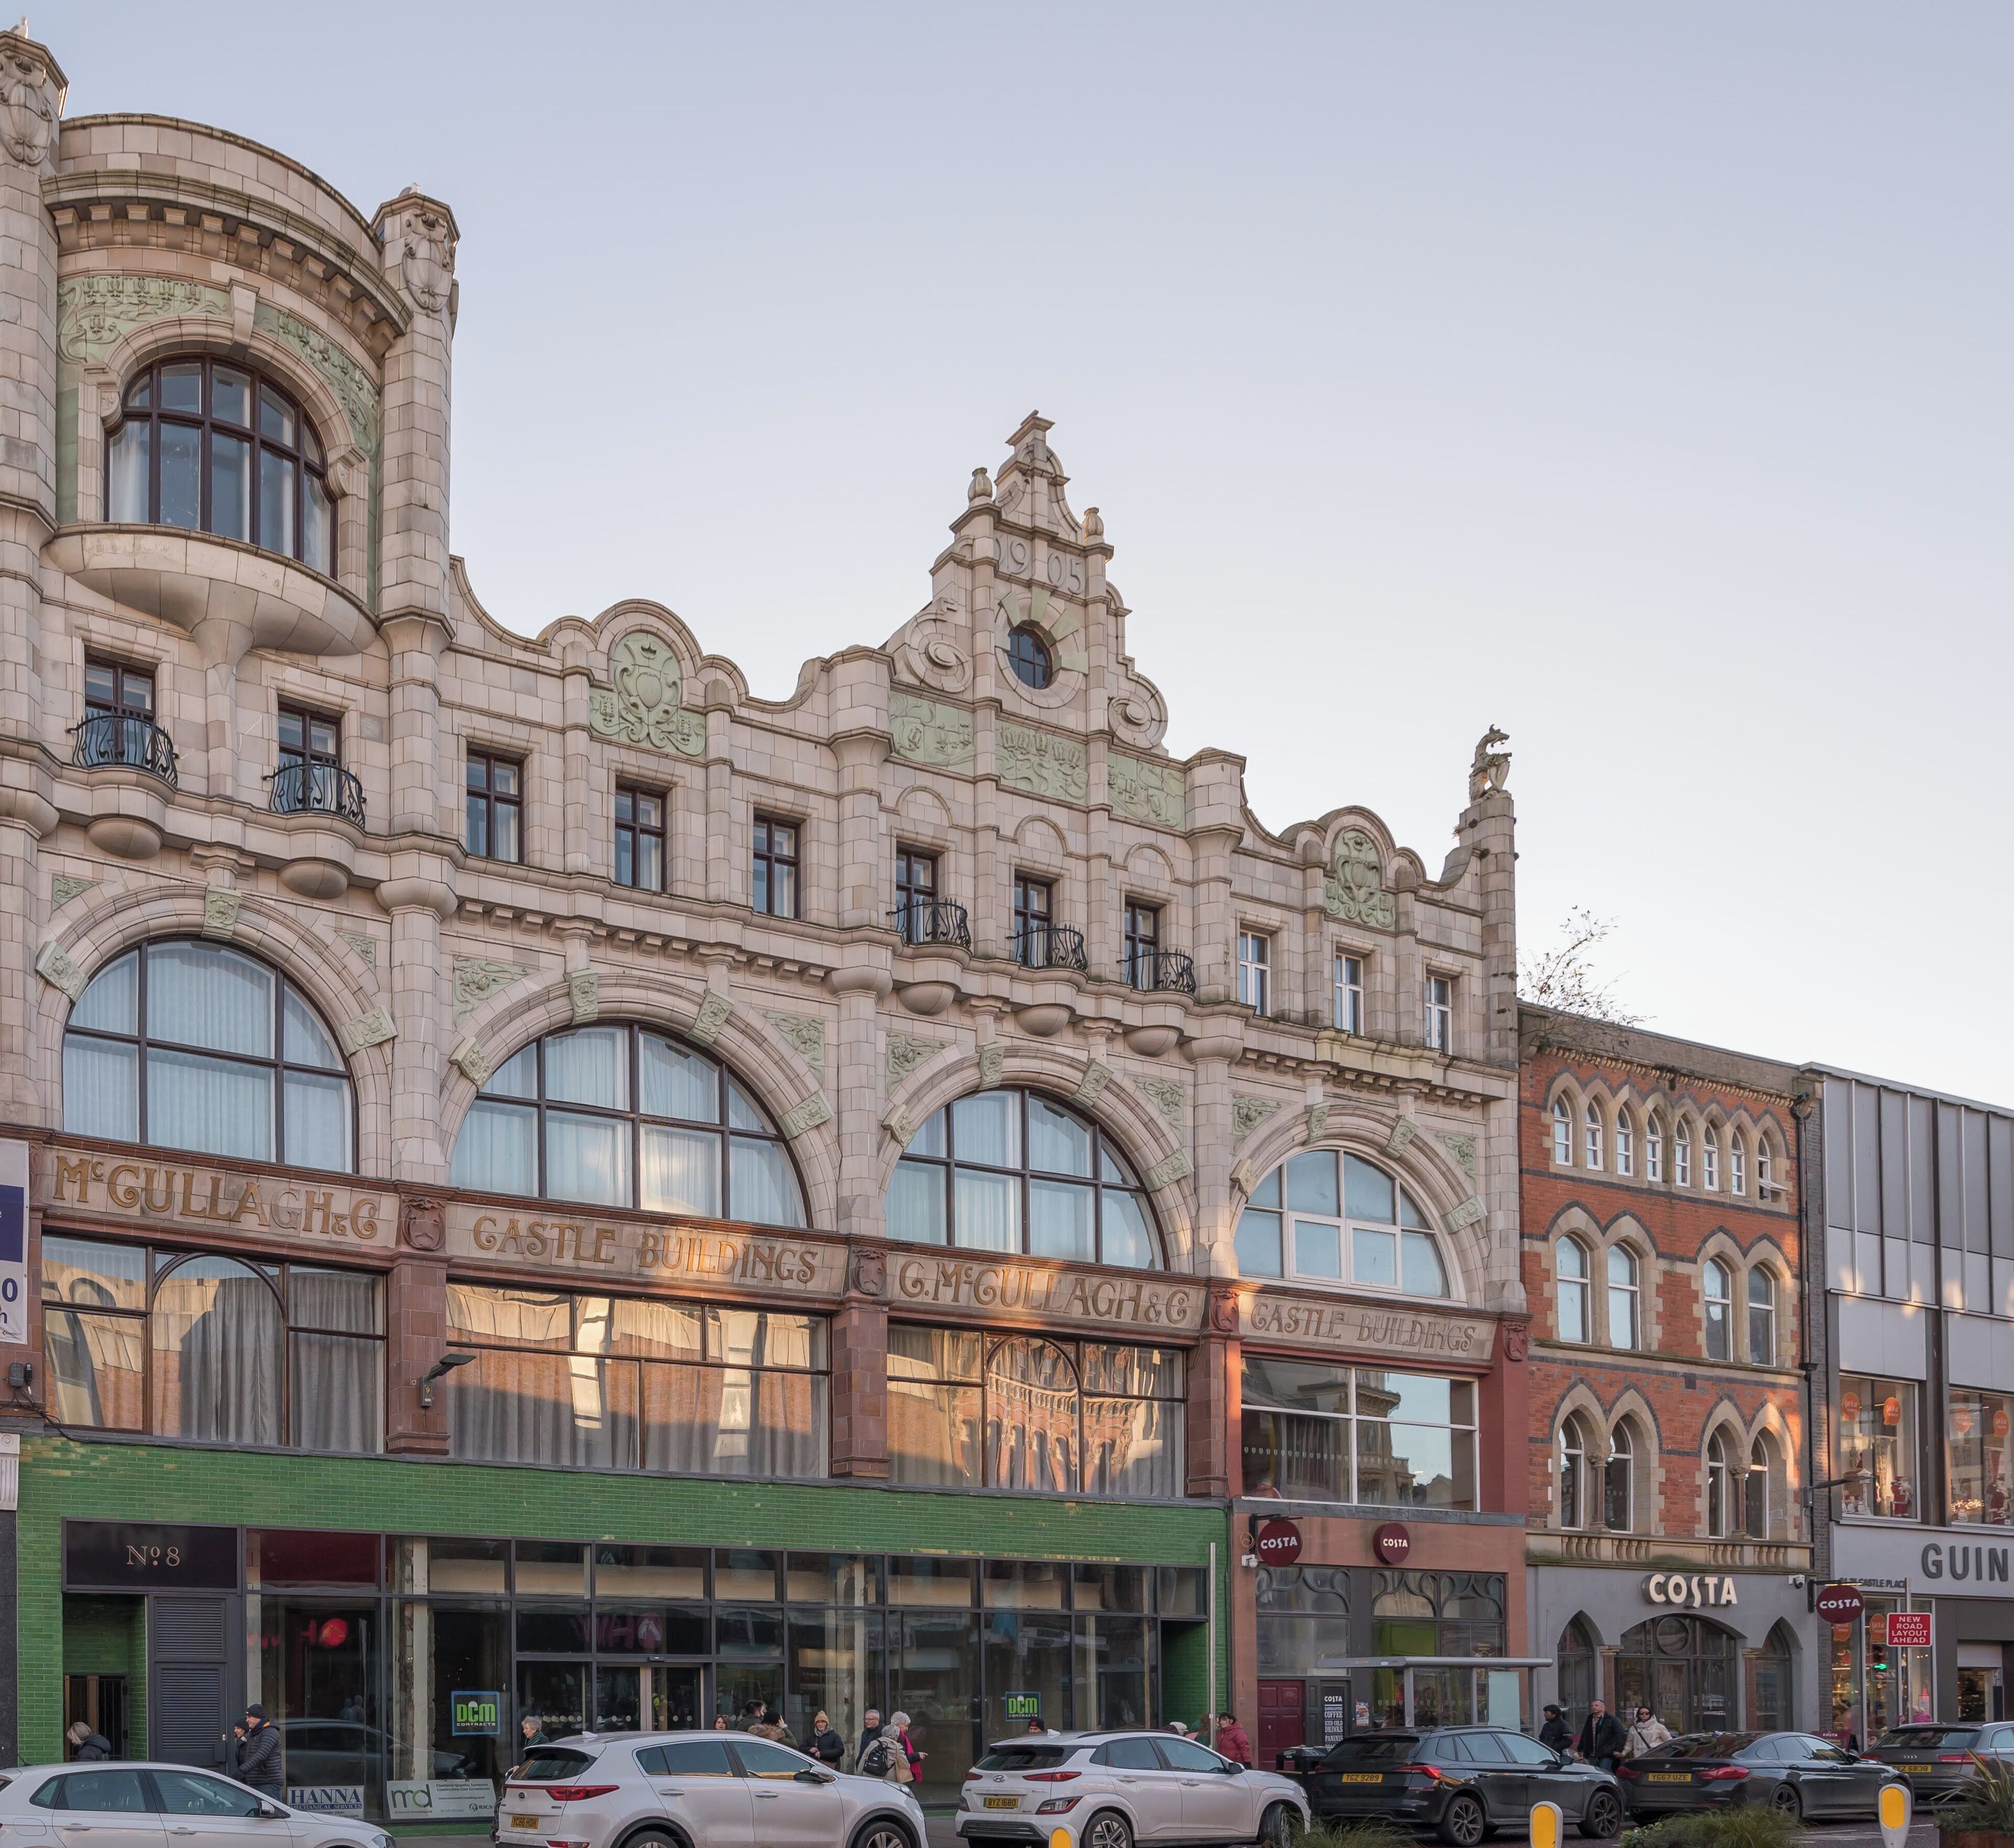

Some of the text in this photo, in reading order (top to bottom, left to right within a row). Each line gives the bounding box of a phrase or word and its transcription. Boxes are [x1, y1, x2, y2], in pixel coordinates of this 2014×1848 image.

[473, 1215, 818, 1284] CASTLE BUILDINGS
[1250, 1302, 1477, 1352] CASTLE BUILDINGS
[1260, 1536, 1298, 1549] COSTA
[1383, 1538, 1408, 1548] COSTA
[166, 1546, 180, 1566] 8
[1922, 1543, 2009, 1582] GUIN
[1648, 1574, 1738, 1608] COSTA
[1886, 1579, 1906, 1588] PLAC
[1819, 1598, 1861, 1609] COSTA
[457, 1701, 496, 1722] DCM
[1009, 1695, 1038, 1714] DCM
[290, 1788, 361, 1804] HANNA
